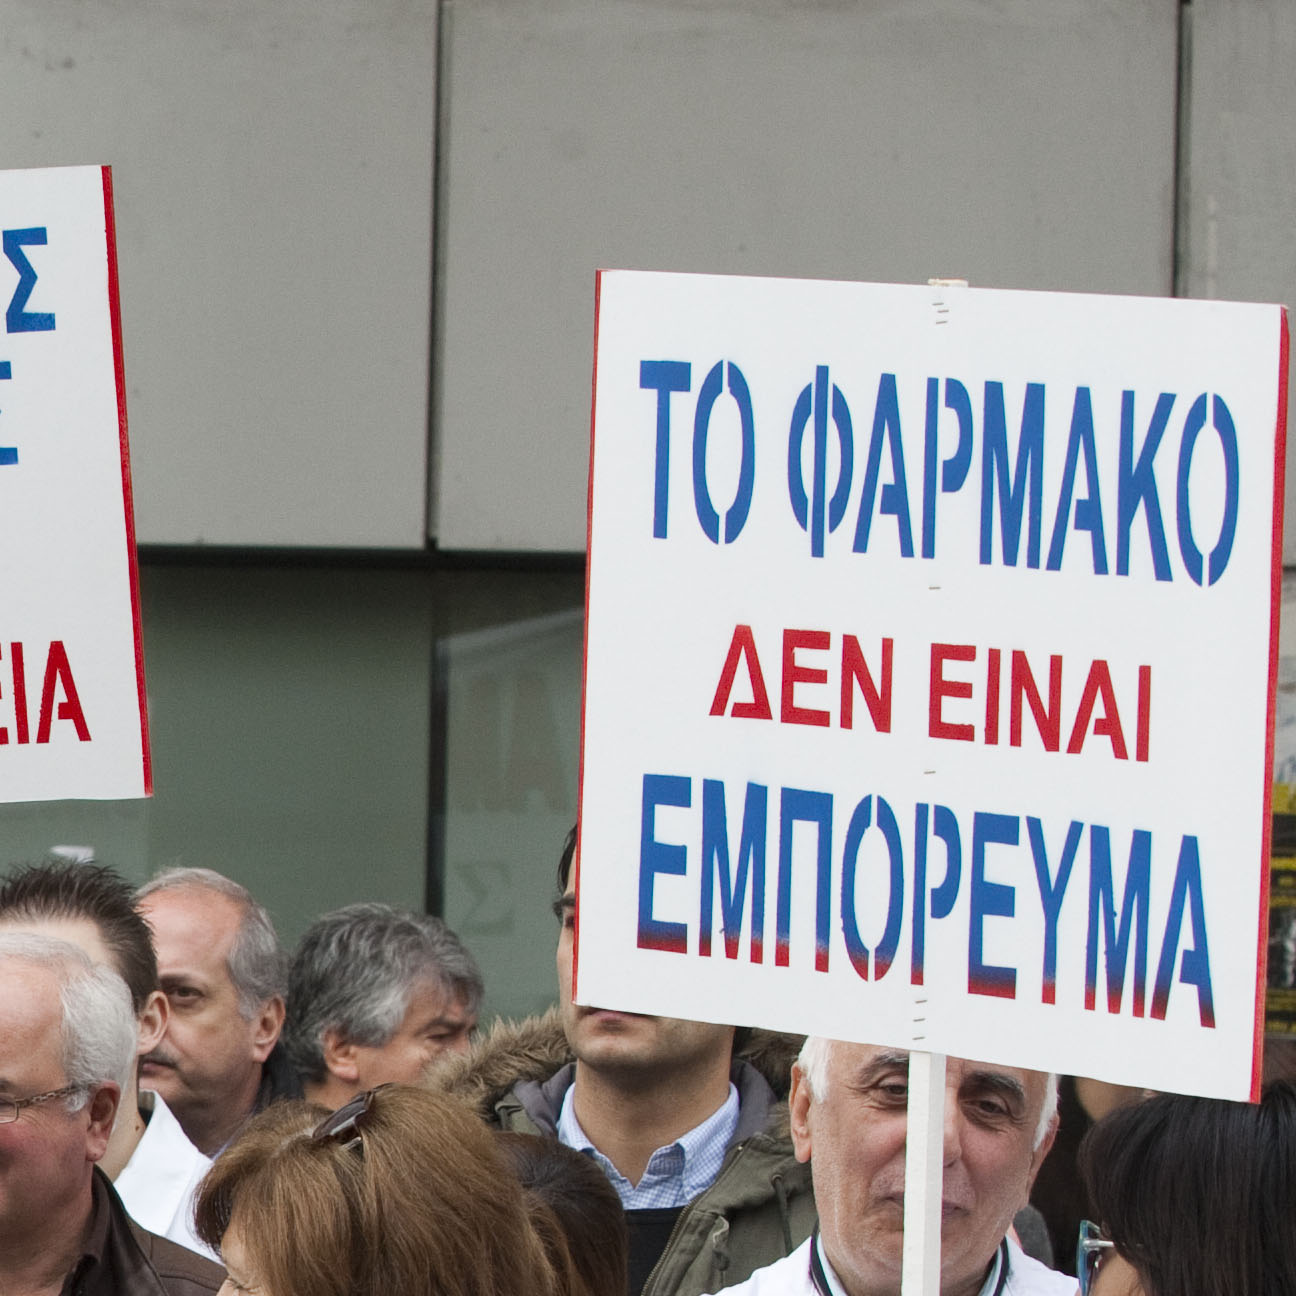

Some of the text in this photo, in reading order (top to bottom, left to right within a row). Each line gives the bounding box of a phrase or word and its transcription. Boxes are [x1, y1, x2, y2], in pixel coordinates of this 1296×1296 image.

[640, 360, 1239, 586] ΤΟ ΦΑΡΜΑΚΟ
[709, 625, 1150, 762] ΔΕΝ ΕΙΝΑΙ
[637, 773, 1214, 1028] ΕΜΠΟΡΕΥΜΑ
